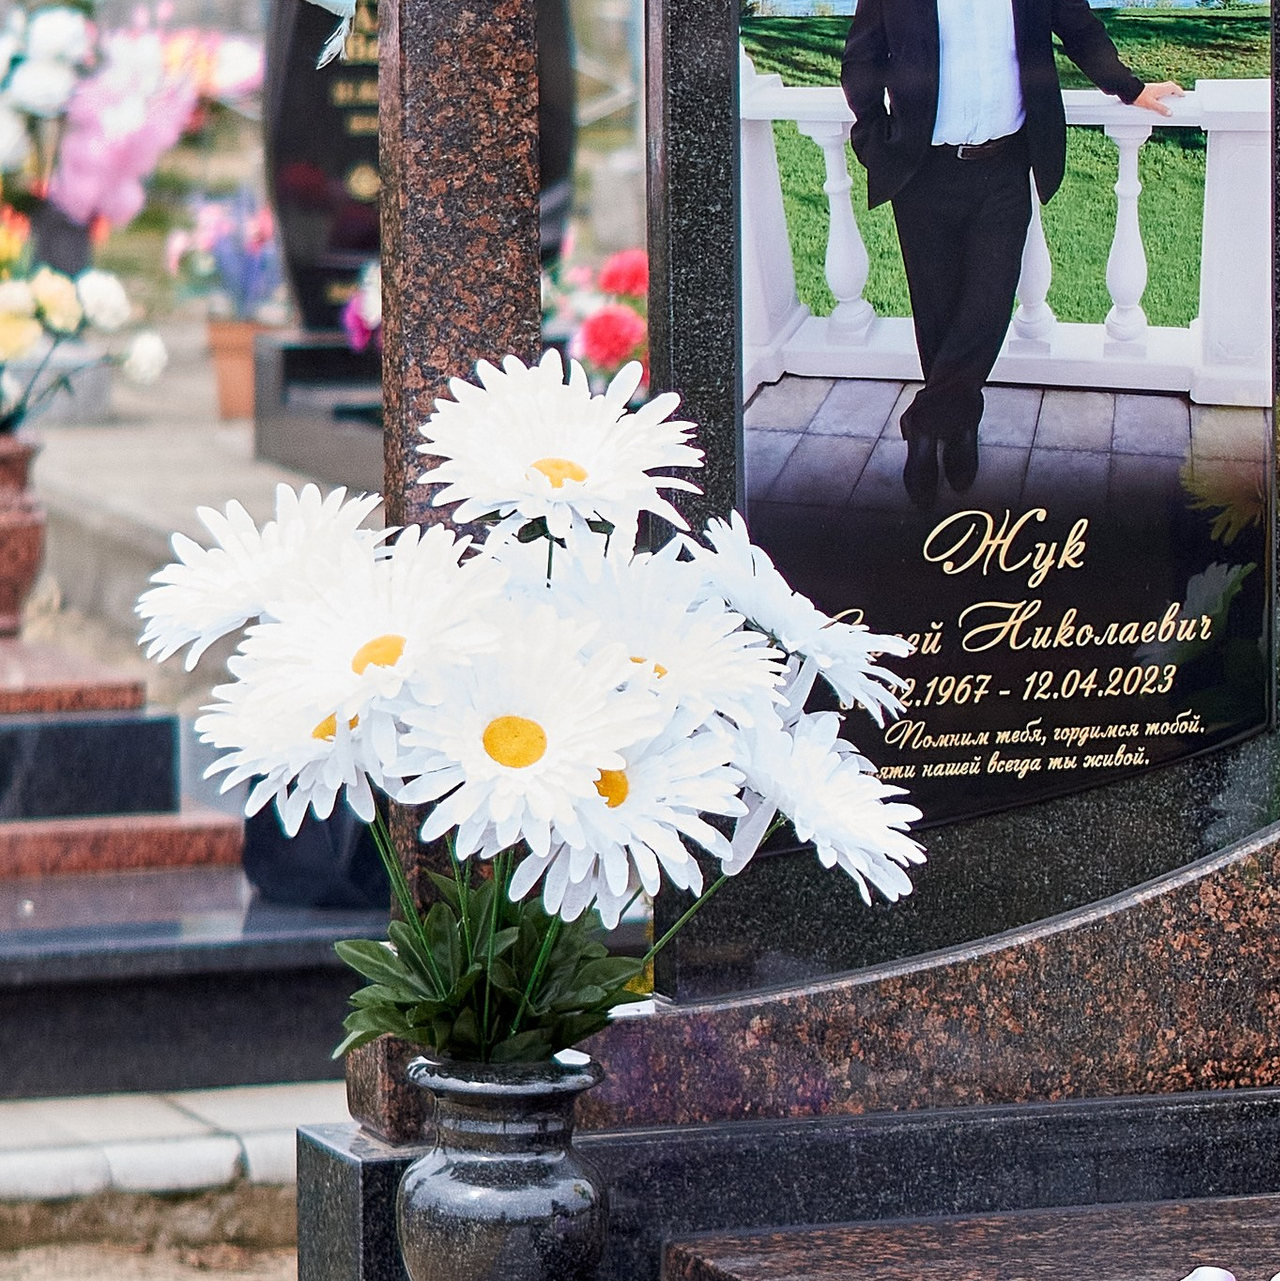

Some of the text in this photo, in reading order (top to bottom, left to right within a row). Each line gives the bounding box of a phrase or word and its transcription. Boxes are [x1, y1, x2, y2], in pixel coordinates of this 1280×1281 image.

[923, 507, 1089, 589] Жук
[958, 599, 1213, 653] Николаевич
[1022, 664, 1178, 701] 12.04.2023
[884, 708, 1206, 750] Помним тебя, гордимся тобой.
[921, 755, 983, 779] нашей
[986, 750, 1043, 780] всегда
[1047, 754, 1078, 771] ты
[1082, 743, 1151, 768] живой.
